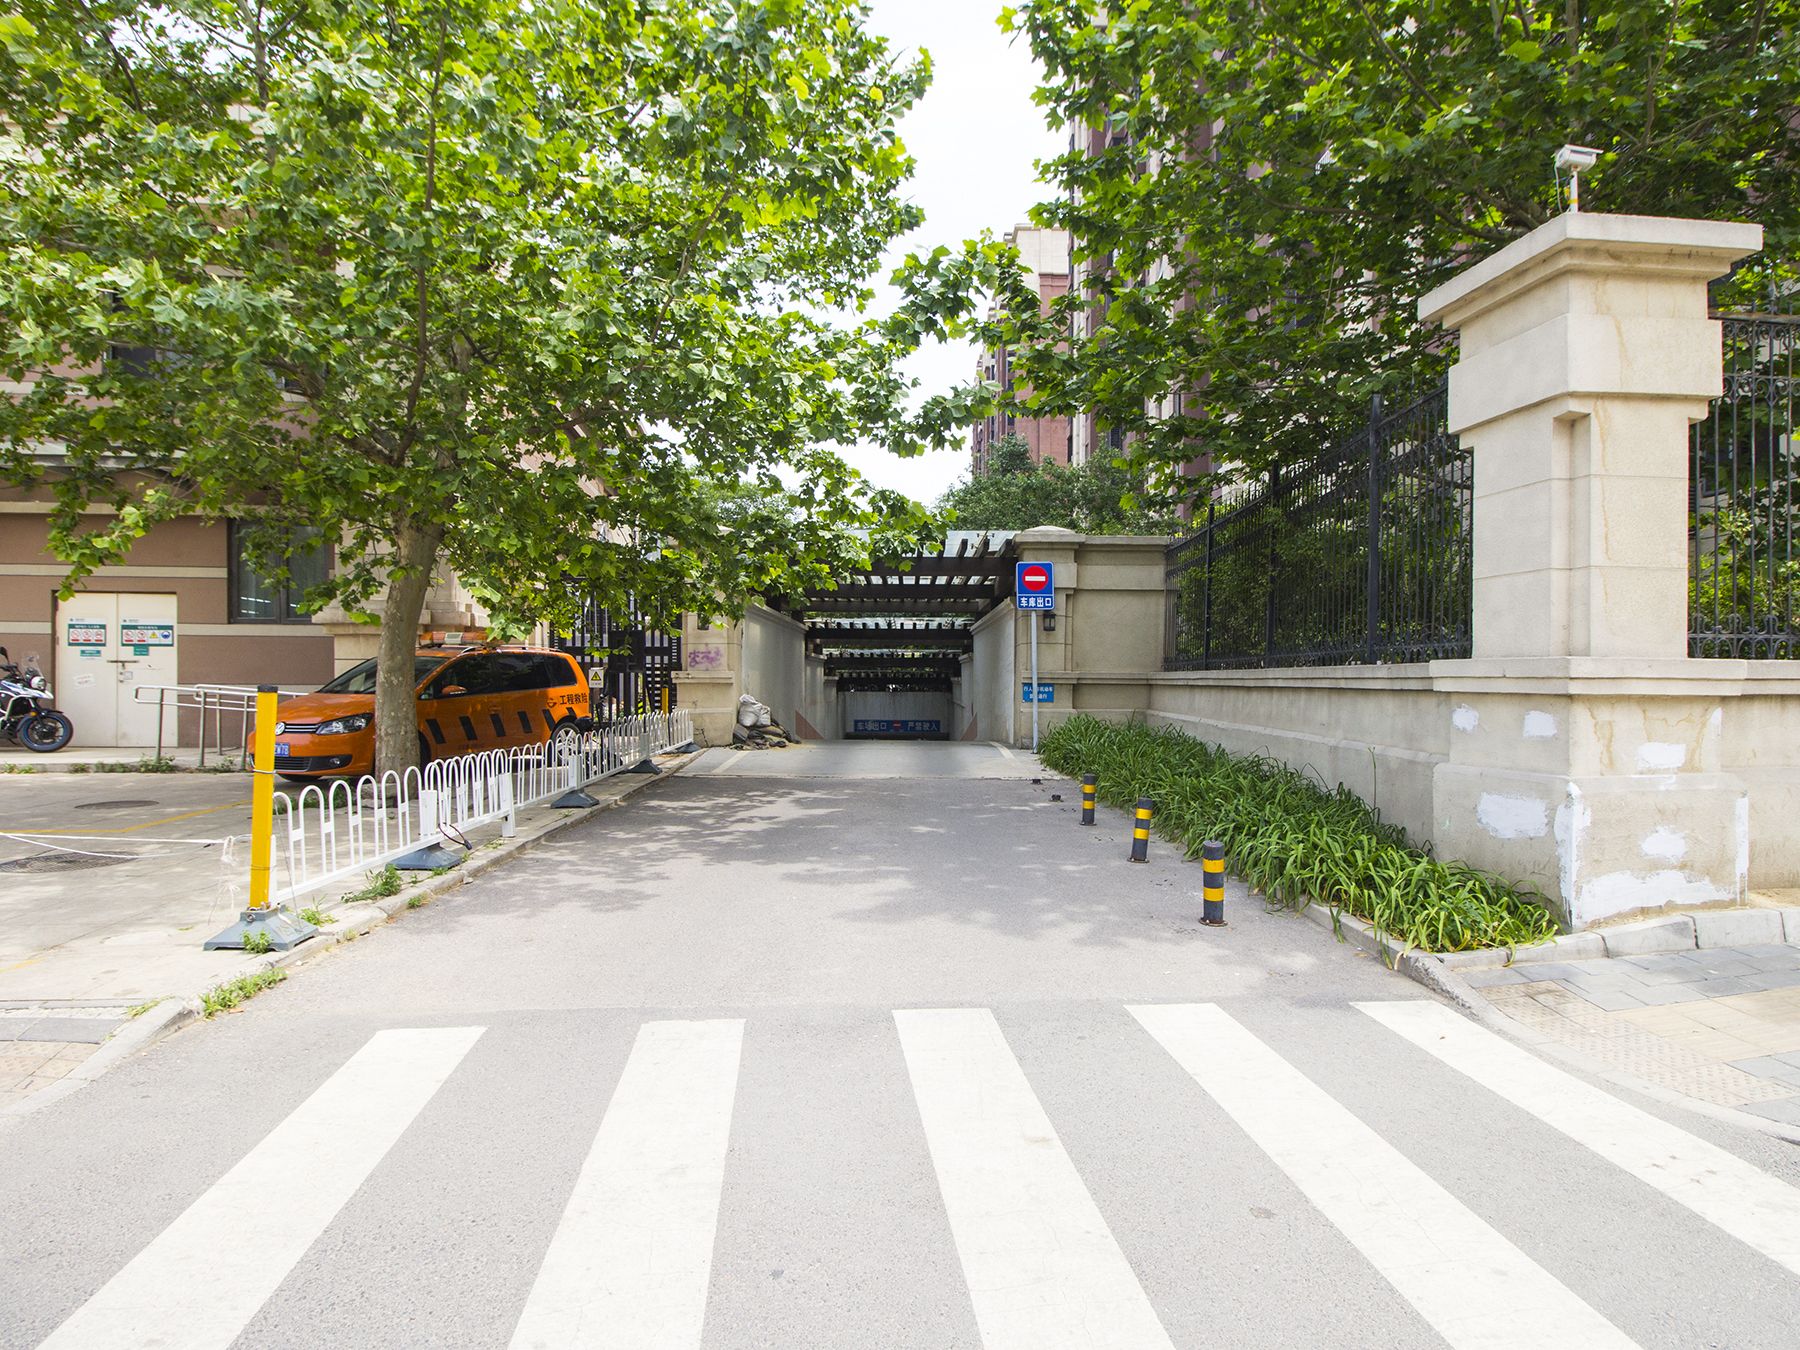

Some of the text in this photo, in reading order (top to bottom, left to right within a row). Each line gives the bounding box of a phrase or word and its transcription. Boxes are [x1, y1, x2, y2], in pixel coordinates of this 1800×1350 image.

[1020, 596, 1052, 607] 车库出口
[559, 692, 588, 704] 工程救险
[907, 721, 938, 731] 严禁驶入
